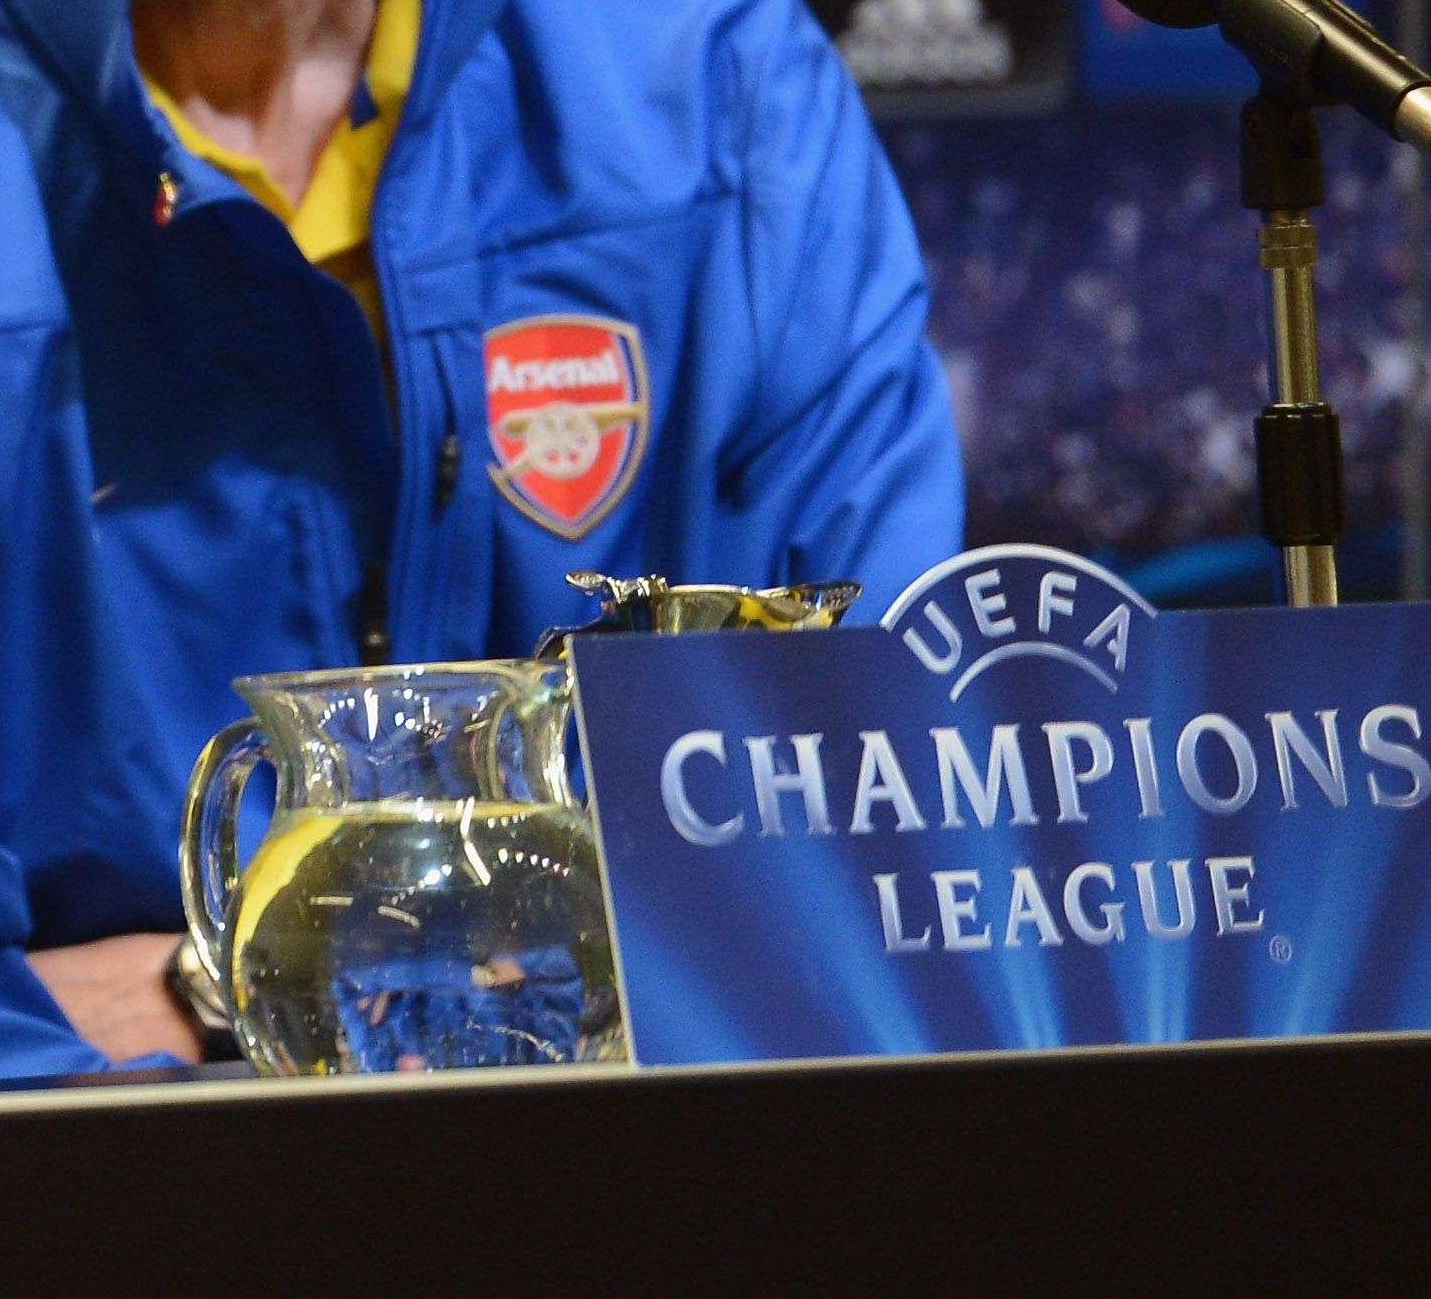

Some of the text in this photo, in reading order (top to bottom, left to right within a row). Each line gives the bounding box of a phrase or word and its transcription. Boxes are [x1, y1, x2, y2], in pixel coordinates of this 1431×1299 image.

[488, 349, 620, 393] Arsenal
[902, 569, 1133, 676] UEFA
[660, 705, 1431, 848] CHAMPIONS
[872, 856, 1266, 955] LEAGUE
